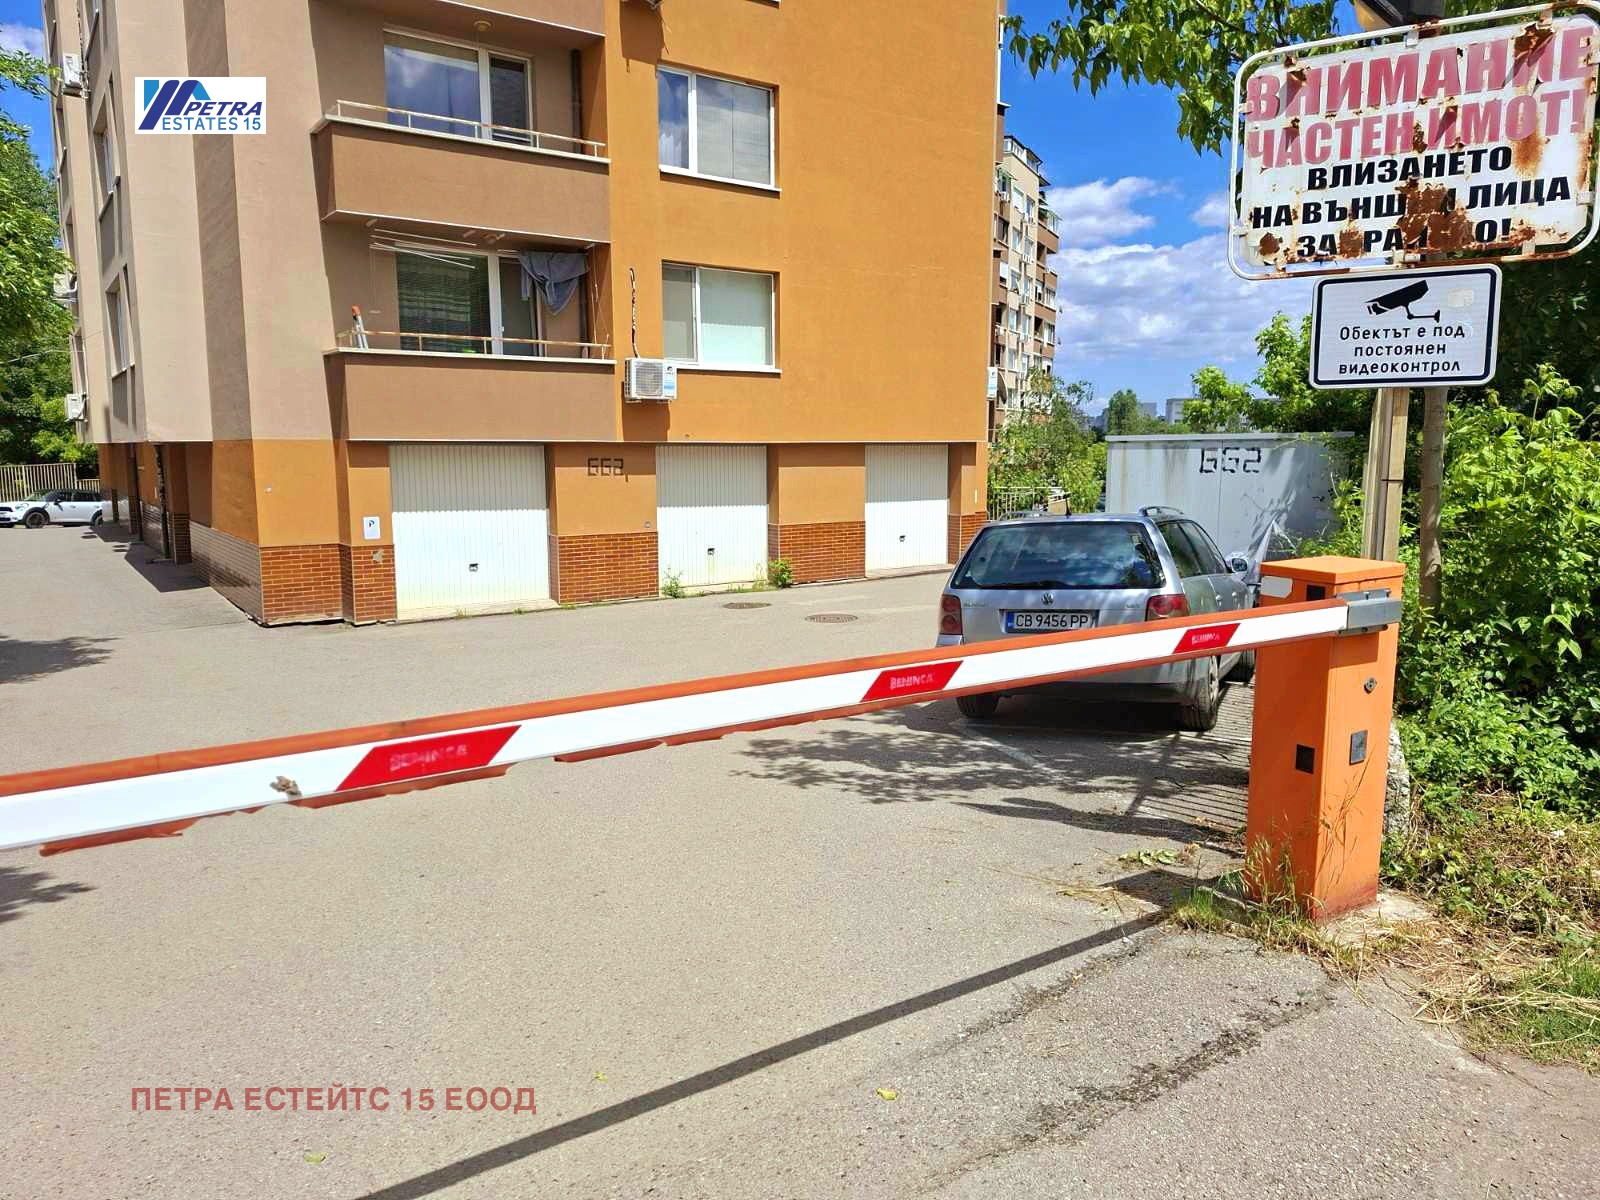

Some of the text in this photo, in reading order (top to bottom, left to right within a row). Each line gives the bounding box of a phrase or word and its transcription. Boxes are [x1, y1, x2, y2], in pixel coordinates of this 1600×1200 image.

[1247, 26, 1594, 121] ВНИМАНИЕ
[1247, 89, 1585, 169] ЧАСТЕН ИМОТ!
[1307, 147, 1512, 190] ВЛИЗАНЕТО
[1252, 205, 1293, 229] НА
[1466, 176, 1571, 210] ЛИЦА
[1340, 325, 1465, 341] Обектът е под
[1354, 343, 1447, 357] постоянен
[1339, 361, 1461, 375] видеоконтрол
[1035, 614, 1067, 628] 9456
